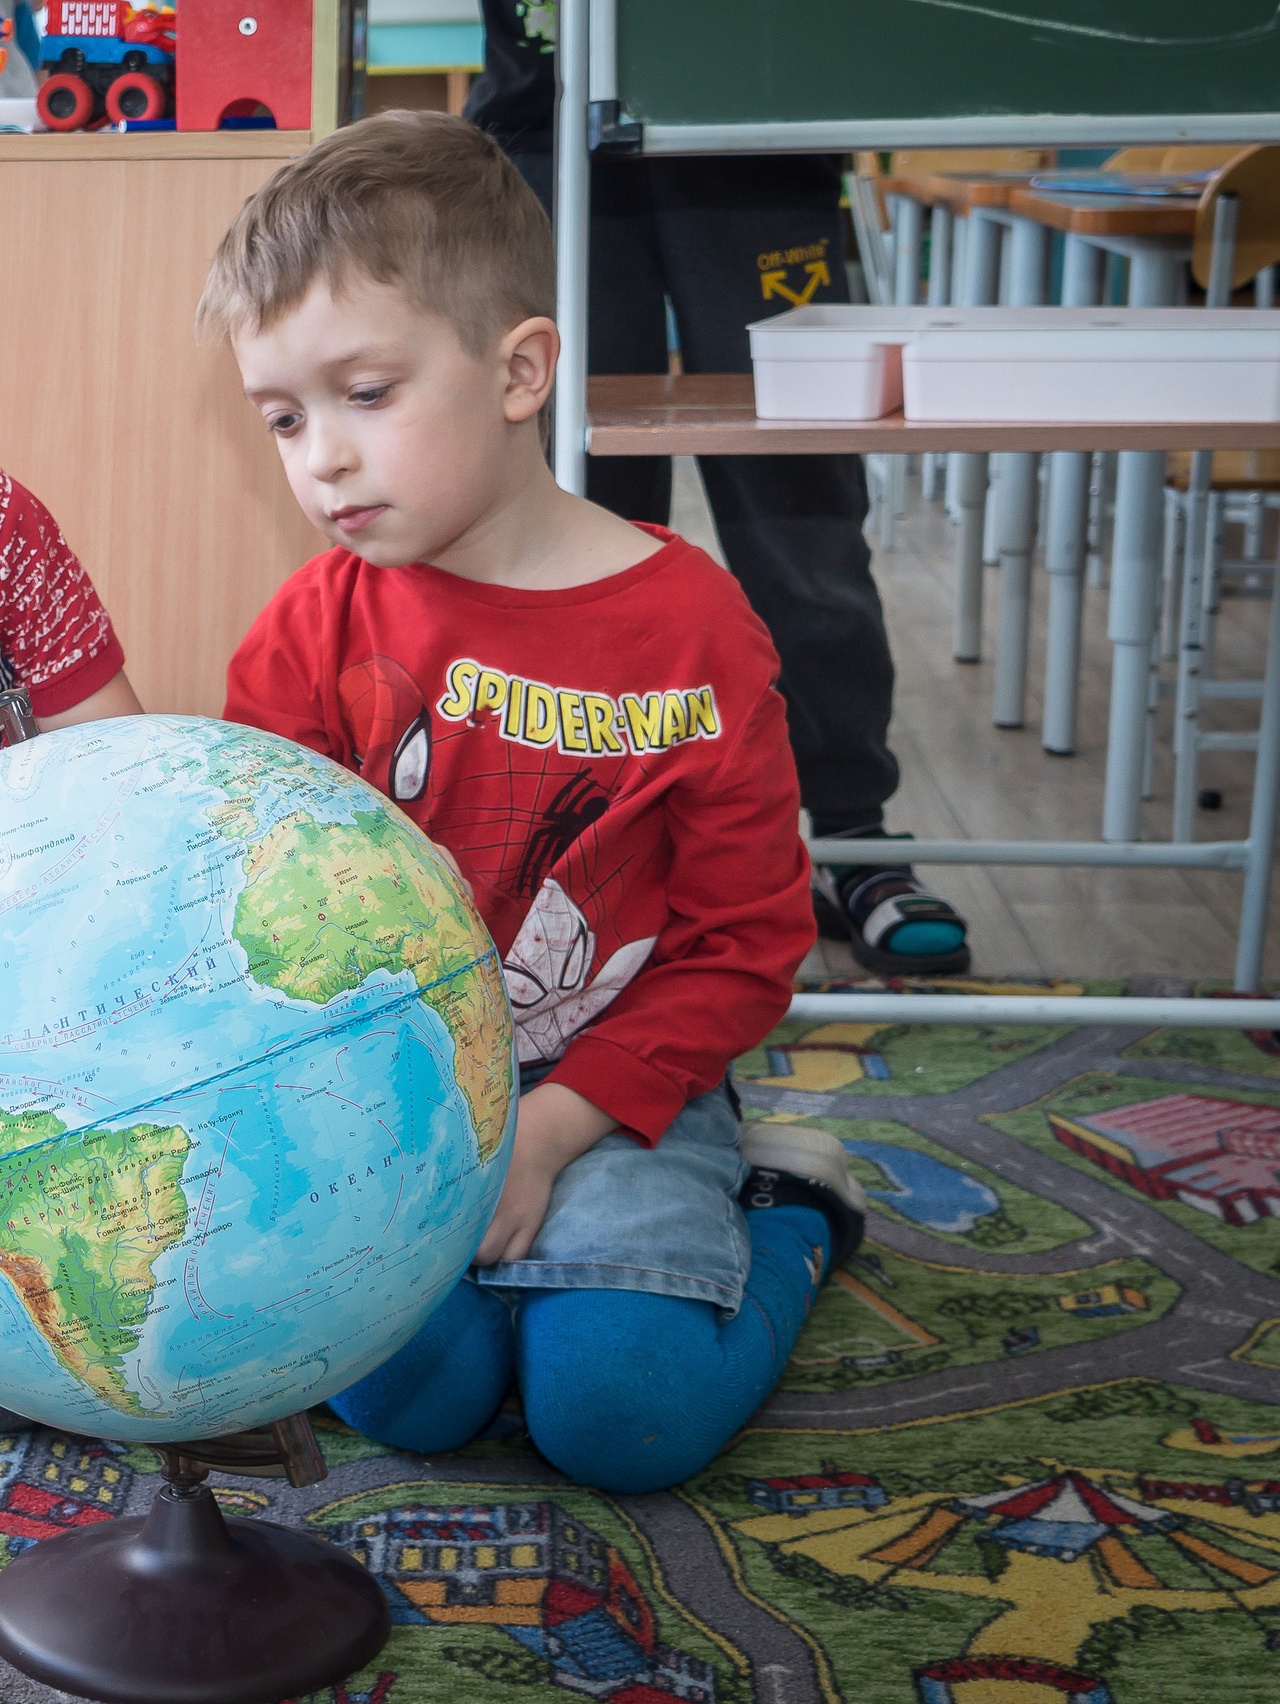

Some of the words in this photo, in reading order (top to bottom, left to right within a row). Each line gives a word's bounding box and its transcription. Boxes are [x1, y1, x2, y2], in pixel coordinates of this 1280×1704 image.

[436, 658, 722, 756] SPIDER-MAN
[143, 776, 176, 793] Ирландия
[195, 828, 214, 840] Рока
[10, 833, 76, 862] Ньюфаундленд
[224, 849, 246, 862] Рабат
[116, 872, 151, 888] Азорские
[152, 864, 169, 876] о-ва
[249, 958, 270, 971] Дакар
[299, 953, 325, 968] Бамако
[14, 1036, 59, 1050] СЕВЕРНОЕ
[63, 1016, 114, 1041] ПАССАТНОЕ
[118, 995, 155, 1019] ТЕЧЕНИЕ
[180, 1040, 194, 1051] 30°
[10, 1094, 54, 1114] Джорджтаун
[48, 1084, 89, 1105] ТЕЧЕНИЕ
[22, 1102, 66, 1122] Парамарибо
[82, 1135, 107, 1147] Белен
[129, 1125, 171, 1143] Форталеза
[171, 1140, 202, 1156] Ресифи
[88, 1151, 164, 1185] Бразильское
[178, 1167, 220, 1186] Салвадор
[310, 1155, 394, 1204] ОКЕАН
[197, 1182, 216, 1236] ТЕЧЕНИЕ
[136, 1206, 198, 1233] Белу-Оризонти
[96, 1224, 126, 1239] Гояния
[162, 1221, 232, 1252] Рио-де-Жанейро
[120, 1278, 178, 1300] Порту-Алегри
[188, 1242, 216, 1322] БРАЗИЛЬСКОЕ
[119, 1304, 170, 1325] Монтевидео
